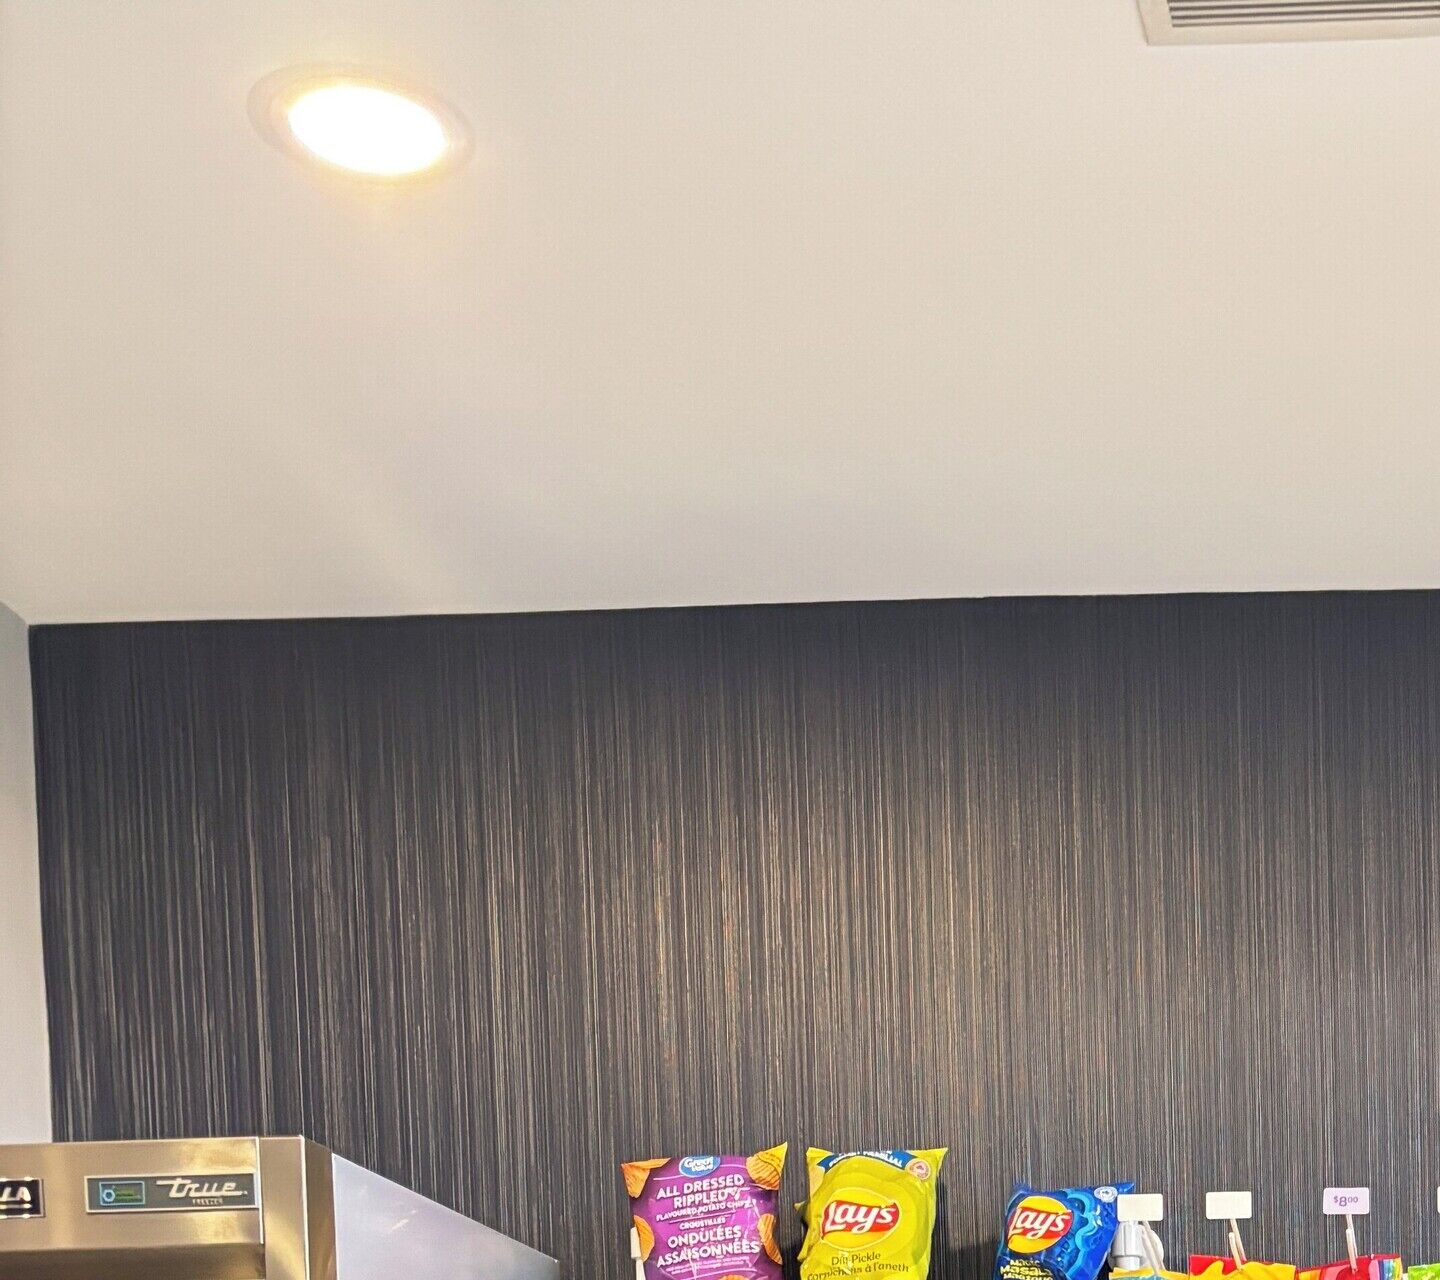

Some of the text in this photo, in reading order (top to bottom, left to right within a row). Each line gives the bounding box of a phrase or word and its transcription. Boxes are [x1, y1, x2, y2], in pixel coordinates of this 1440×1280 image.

[656, 1174, 745, 1200] ALL DRESSED
[824, 1200, 899, 1233] Lay's
[1006, 1206, 1073, 1240] Lay's
[667, 1225, 742, 1248] ONDULÉES
[657, 1239, 761, 1268] ASSAISONNÉES
[851, 1250, 881, 1263] Pickle
